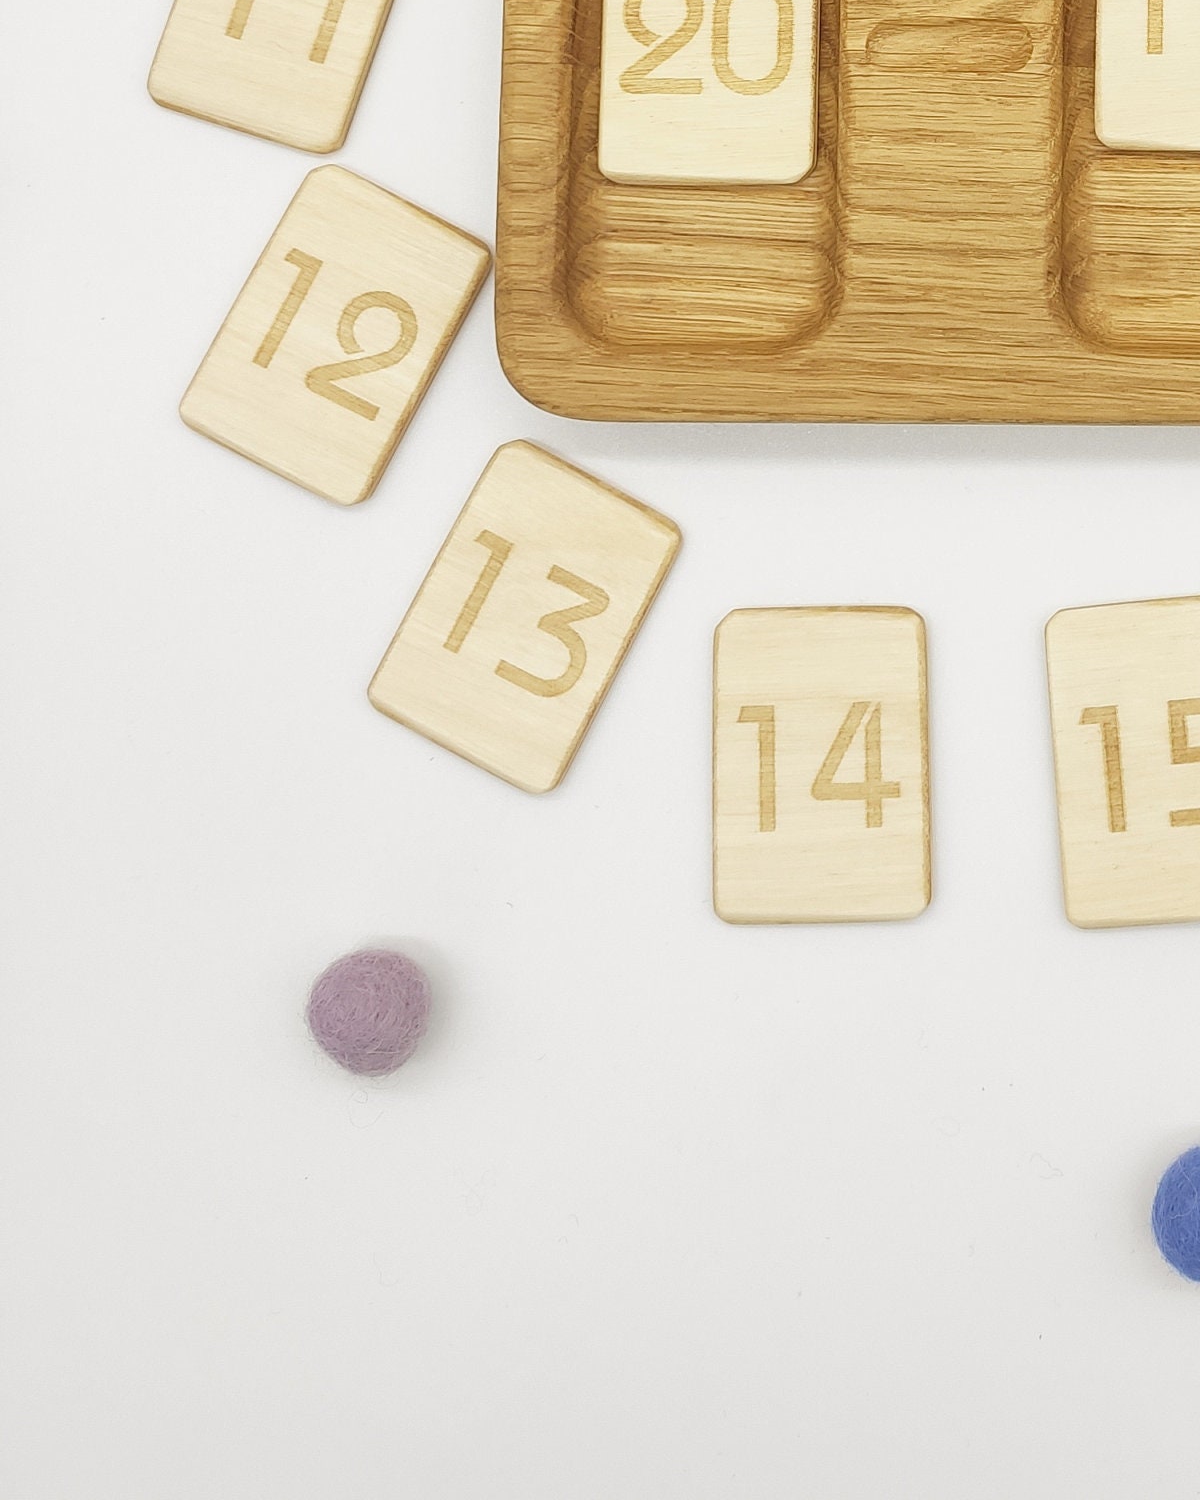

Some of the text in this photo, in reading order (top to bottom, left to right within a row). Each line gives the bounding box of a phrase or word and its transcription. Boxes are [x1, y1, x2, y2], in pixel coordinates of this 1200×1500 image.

[254, 249, 420, 421] 12
[445, 531, 610, 699] 13
[738, 702, 902, 833] 14
